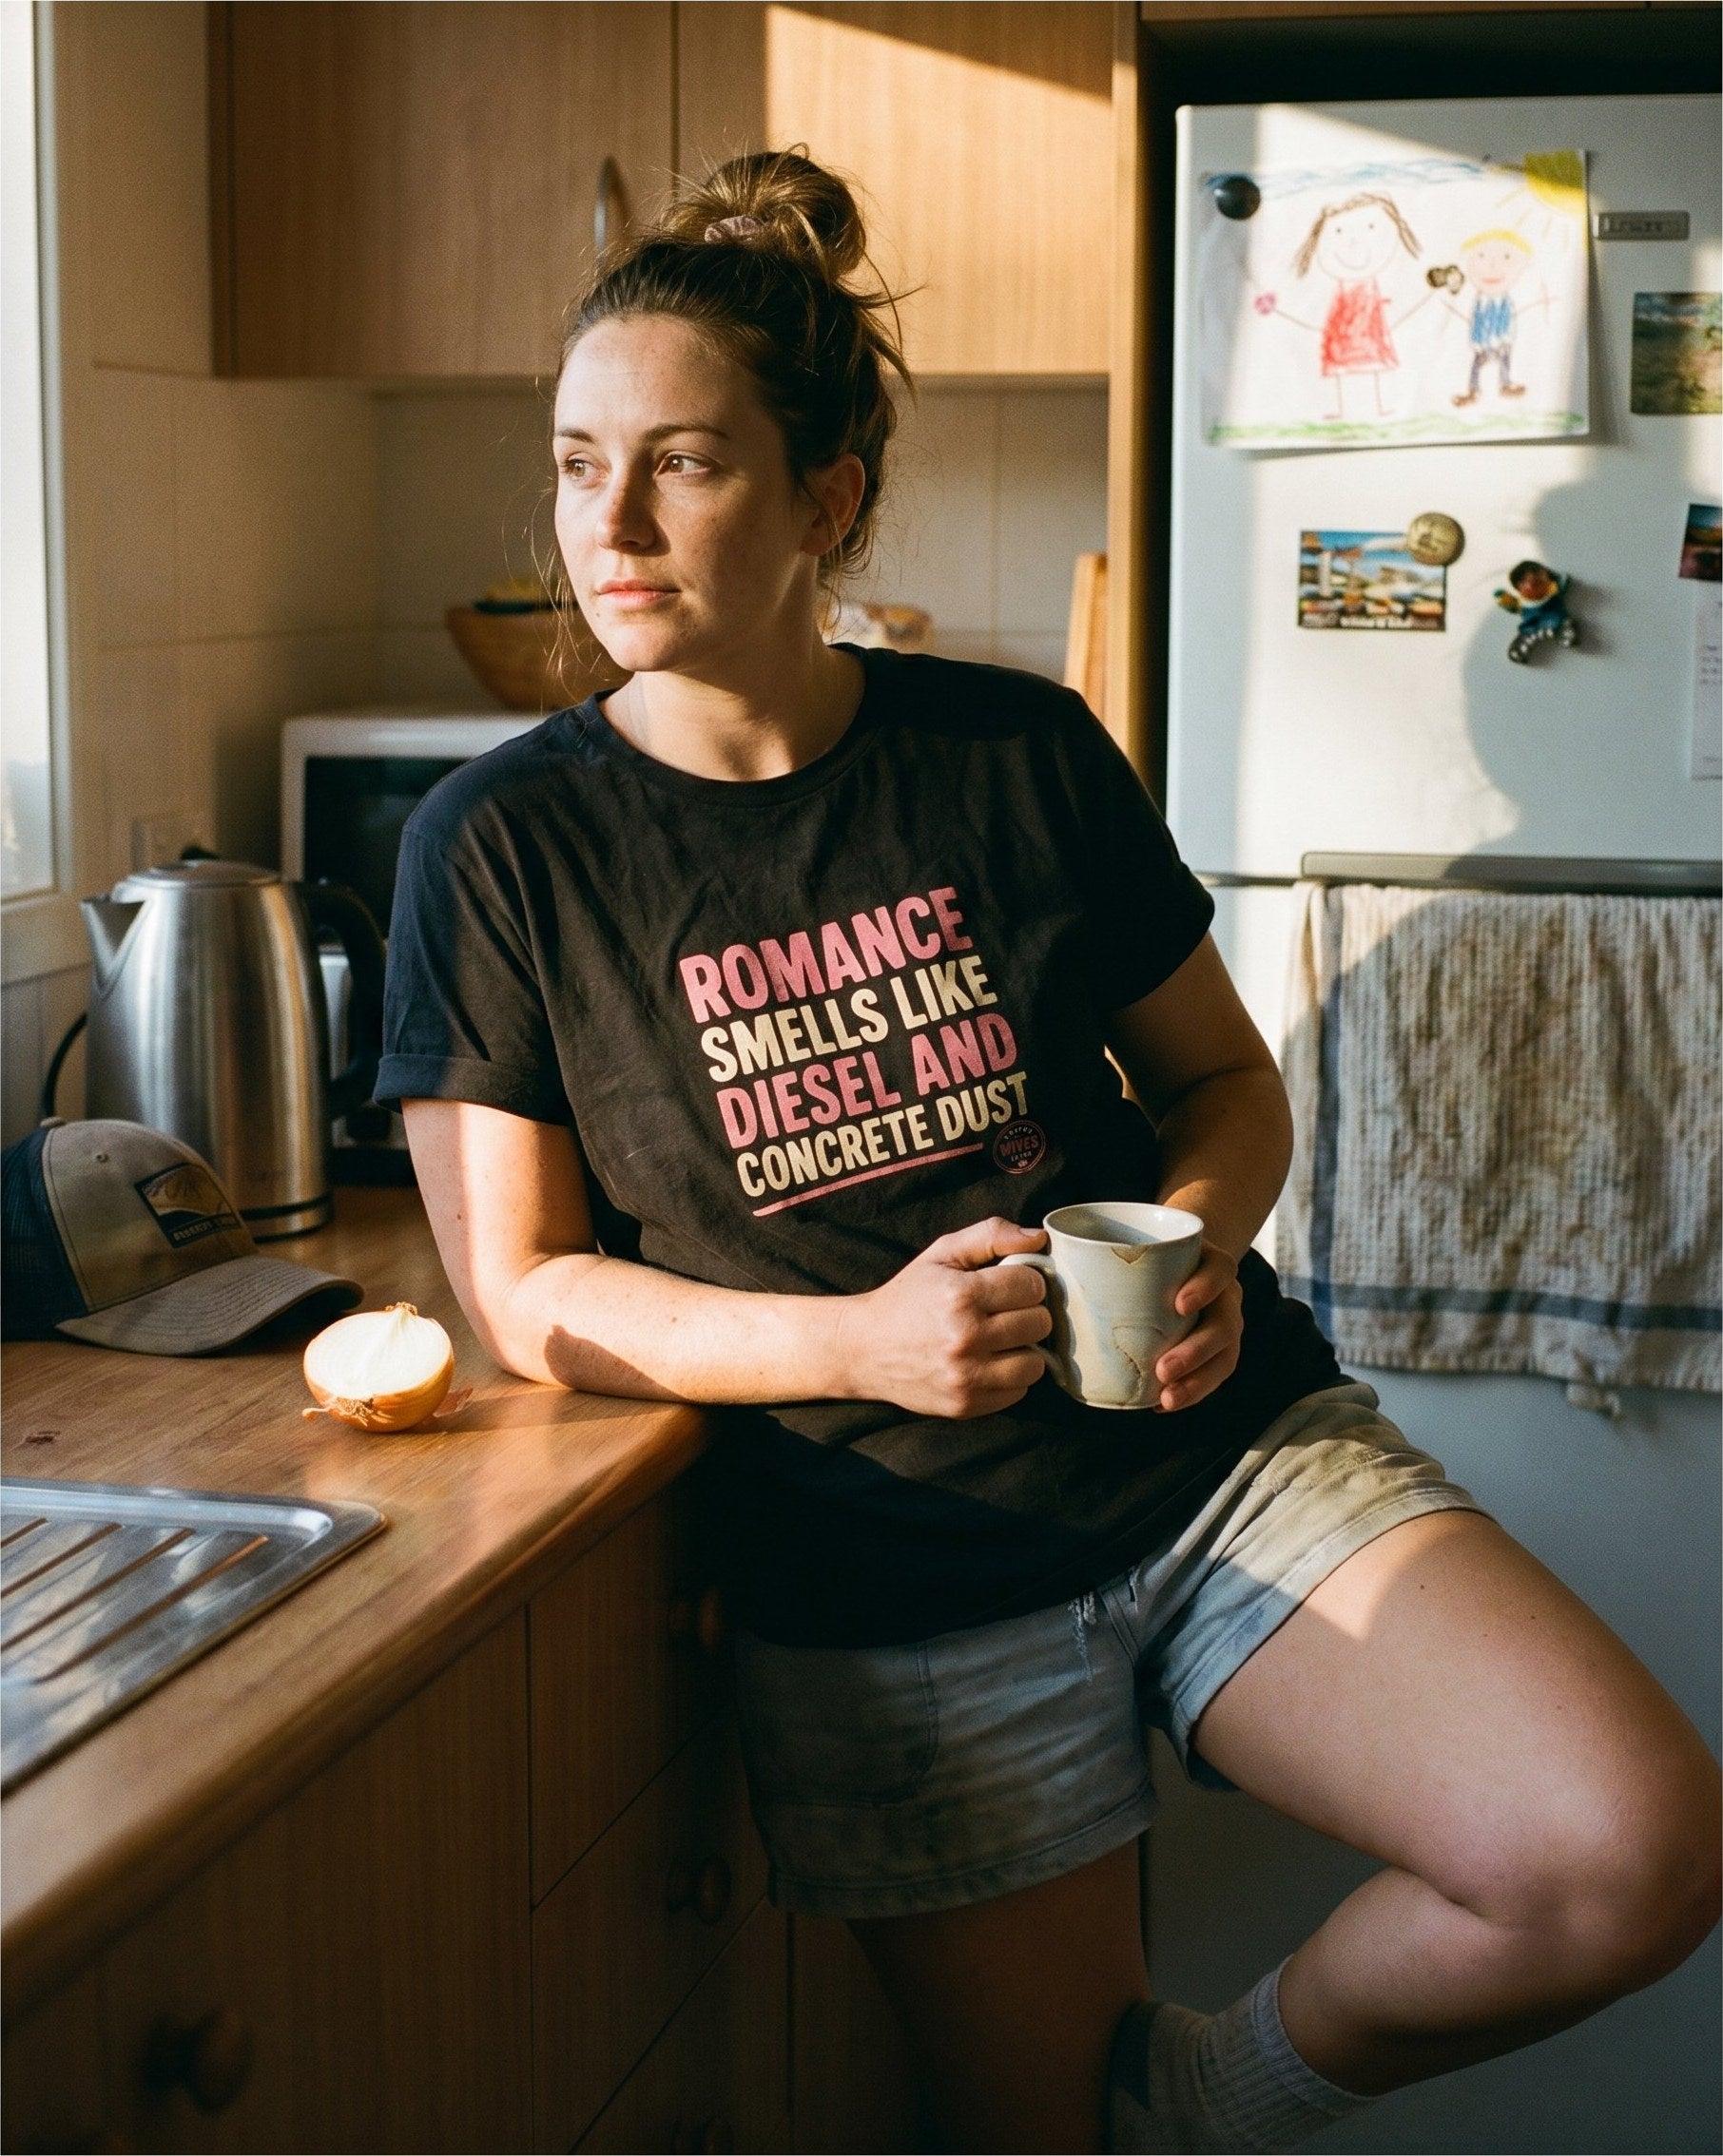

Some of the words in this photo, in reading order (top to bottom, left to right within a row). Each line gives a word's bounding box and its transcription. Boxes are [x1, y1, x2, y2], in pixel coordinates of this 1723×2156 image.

[679, 887, 974, 1024] ROMANCE
[701, 988, 889, 1083] SMELLS
[890, 955, 998, 1030] LIKE
[716, 1051, 902, 1150] DIESEL
[911, 1013, 1017, 1097] AND
[736, 1104, 934, 1198] CONCRETE
[936, 1070, 1029, 1142] DUST
